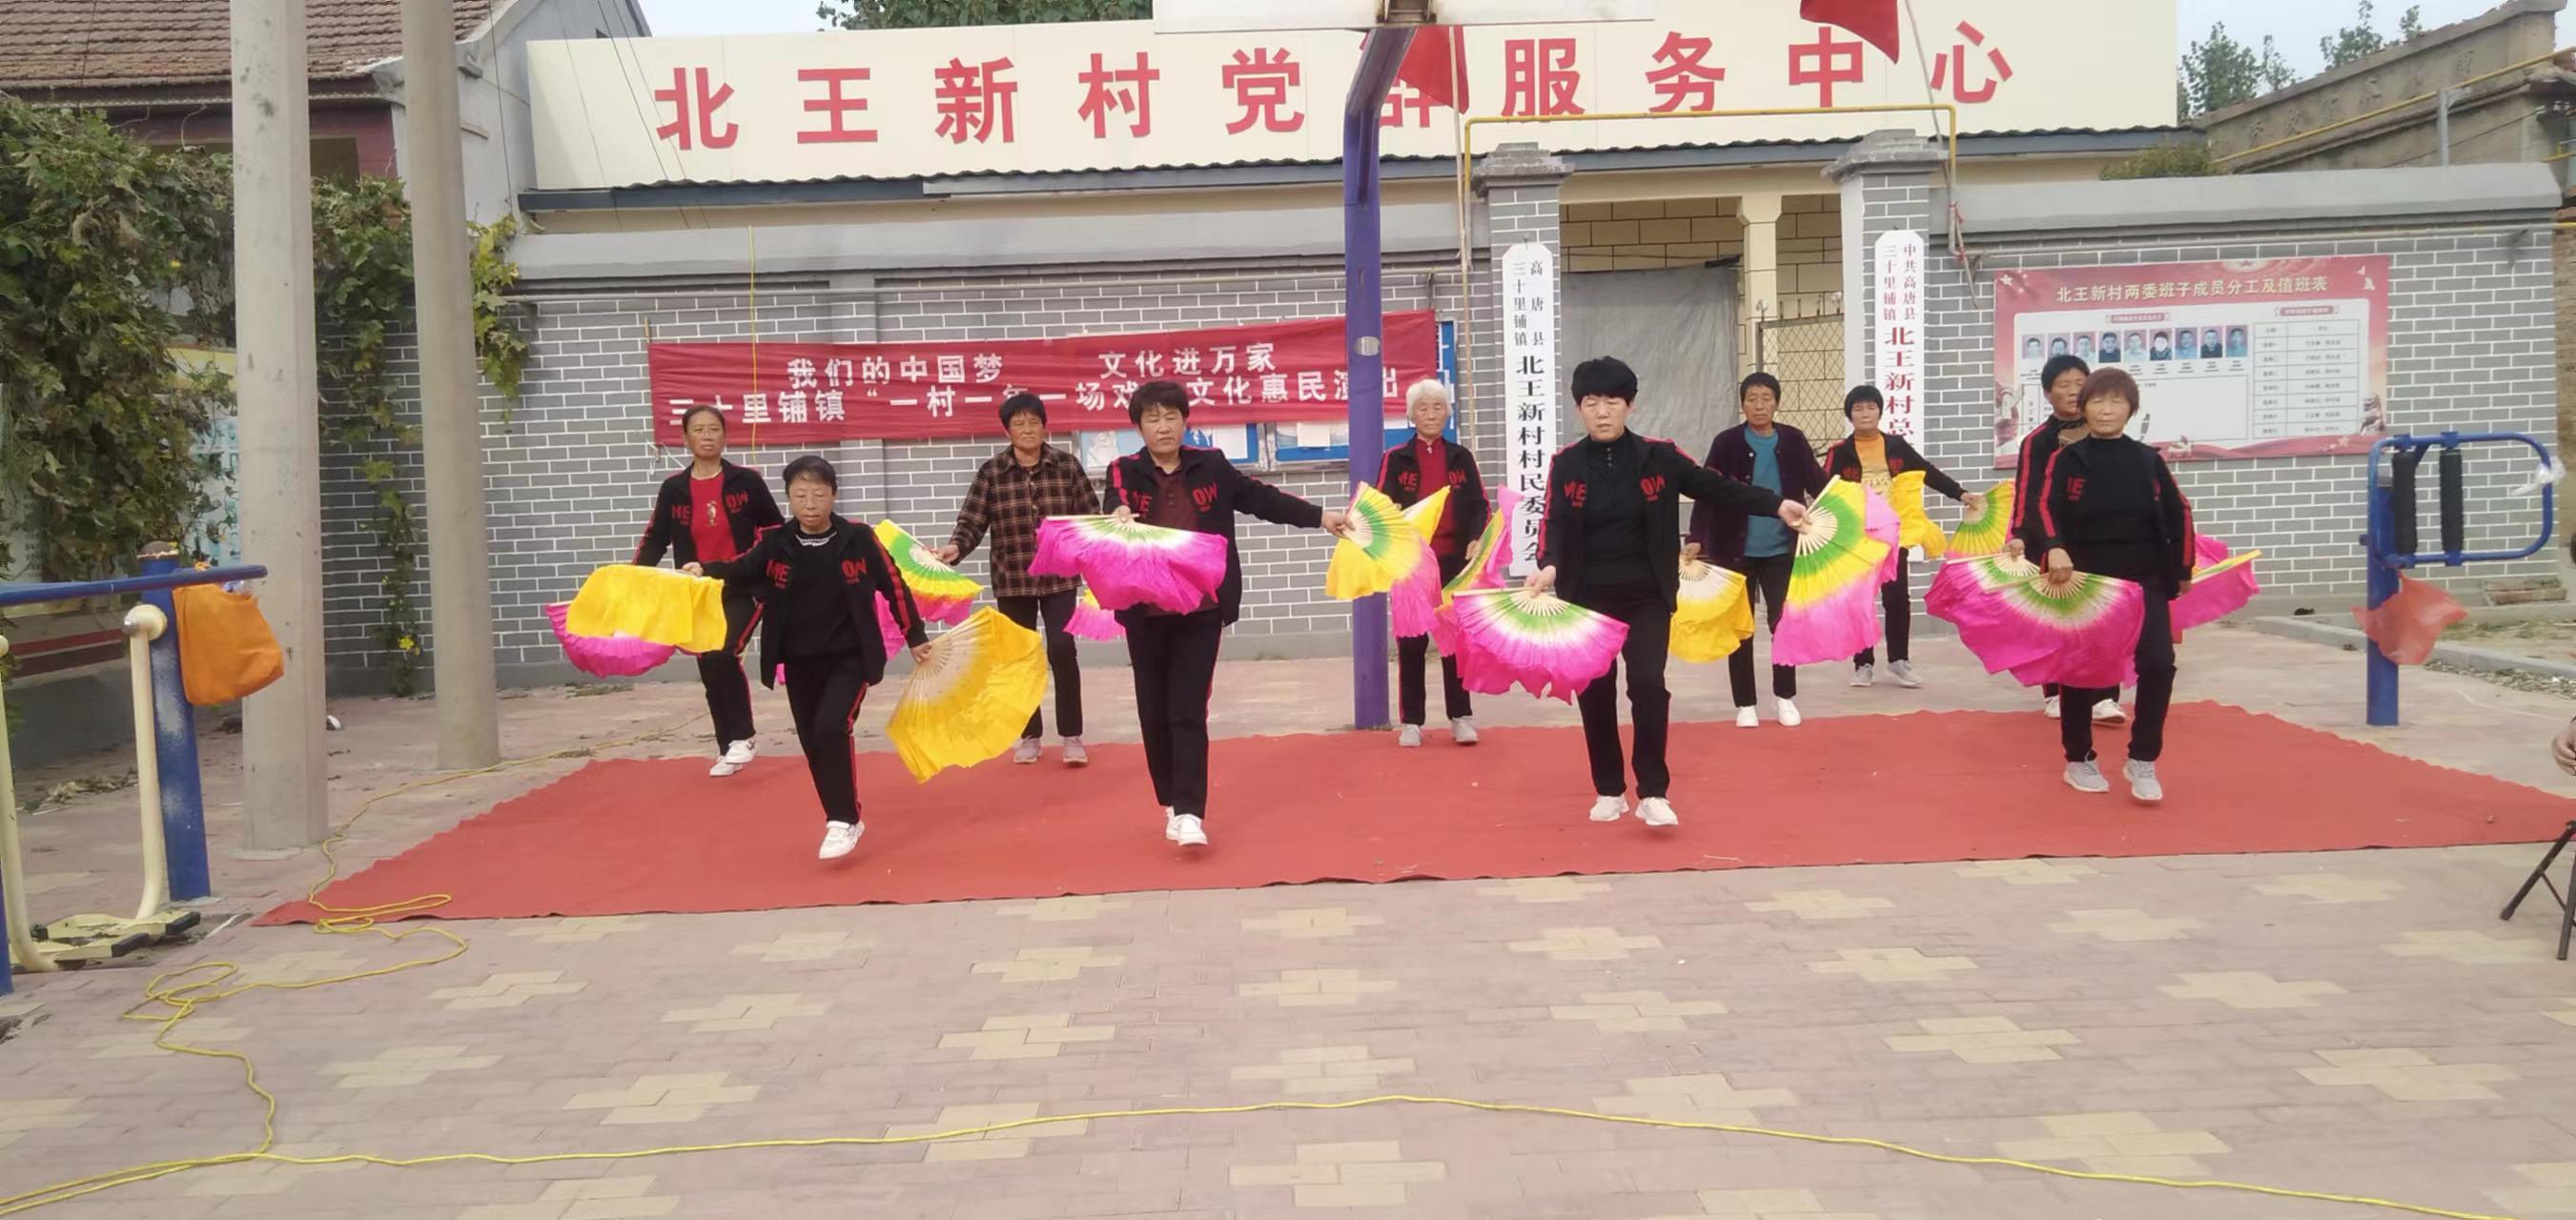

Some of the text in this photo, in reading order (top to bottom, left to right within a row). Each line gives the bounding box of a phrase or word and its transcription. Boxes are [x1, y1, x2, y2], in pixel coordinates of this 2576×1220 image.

[1512, 261, 1528, 347] 三十里铺镇
[1529, 259, 1545, 347] 高唐县
[1883, 245, 1898, 321] 三十里铺镇
[1903, 243, 1917, 321] 中共高唐县
[2056, 275, 2328, 303] 北王新村两委班子成员分工及值班表
[787, 342, 1277, 389] 我们的中国梦 文化进万家
[1884, 326, 1915, 445] 北王新村总
